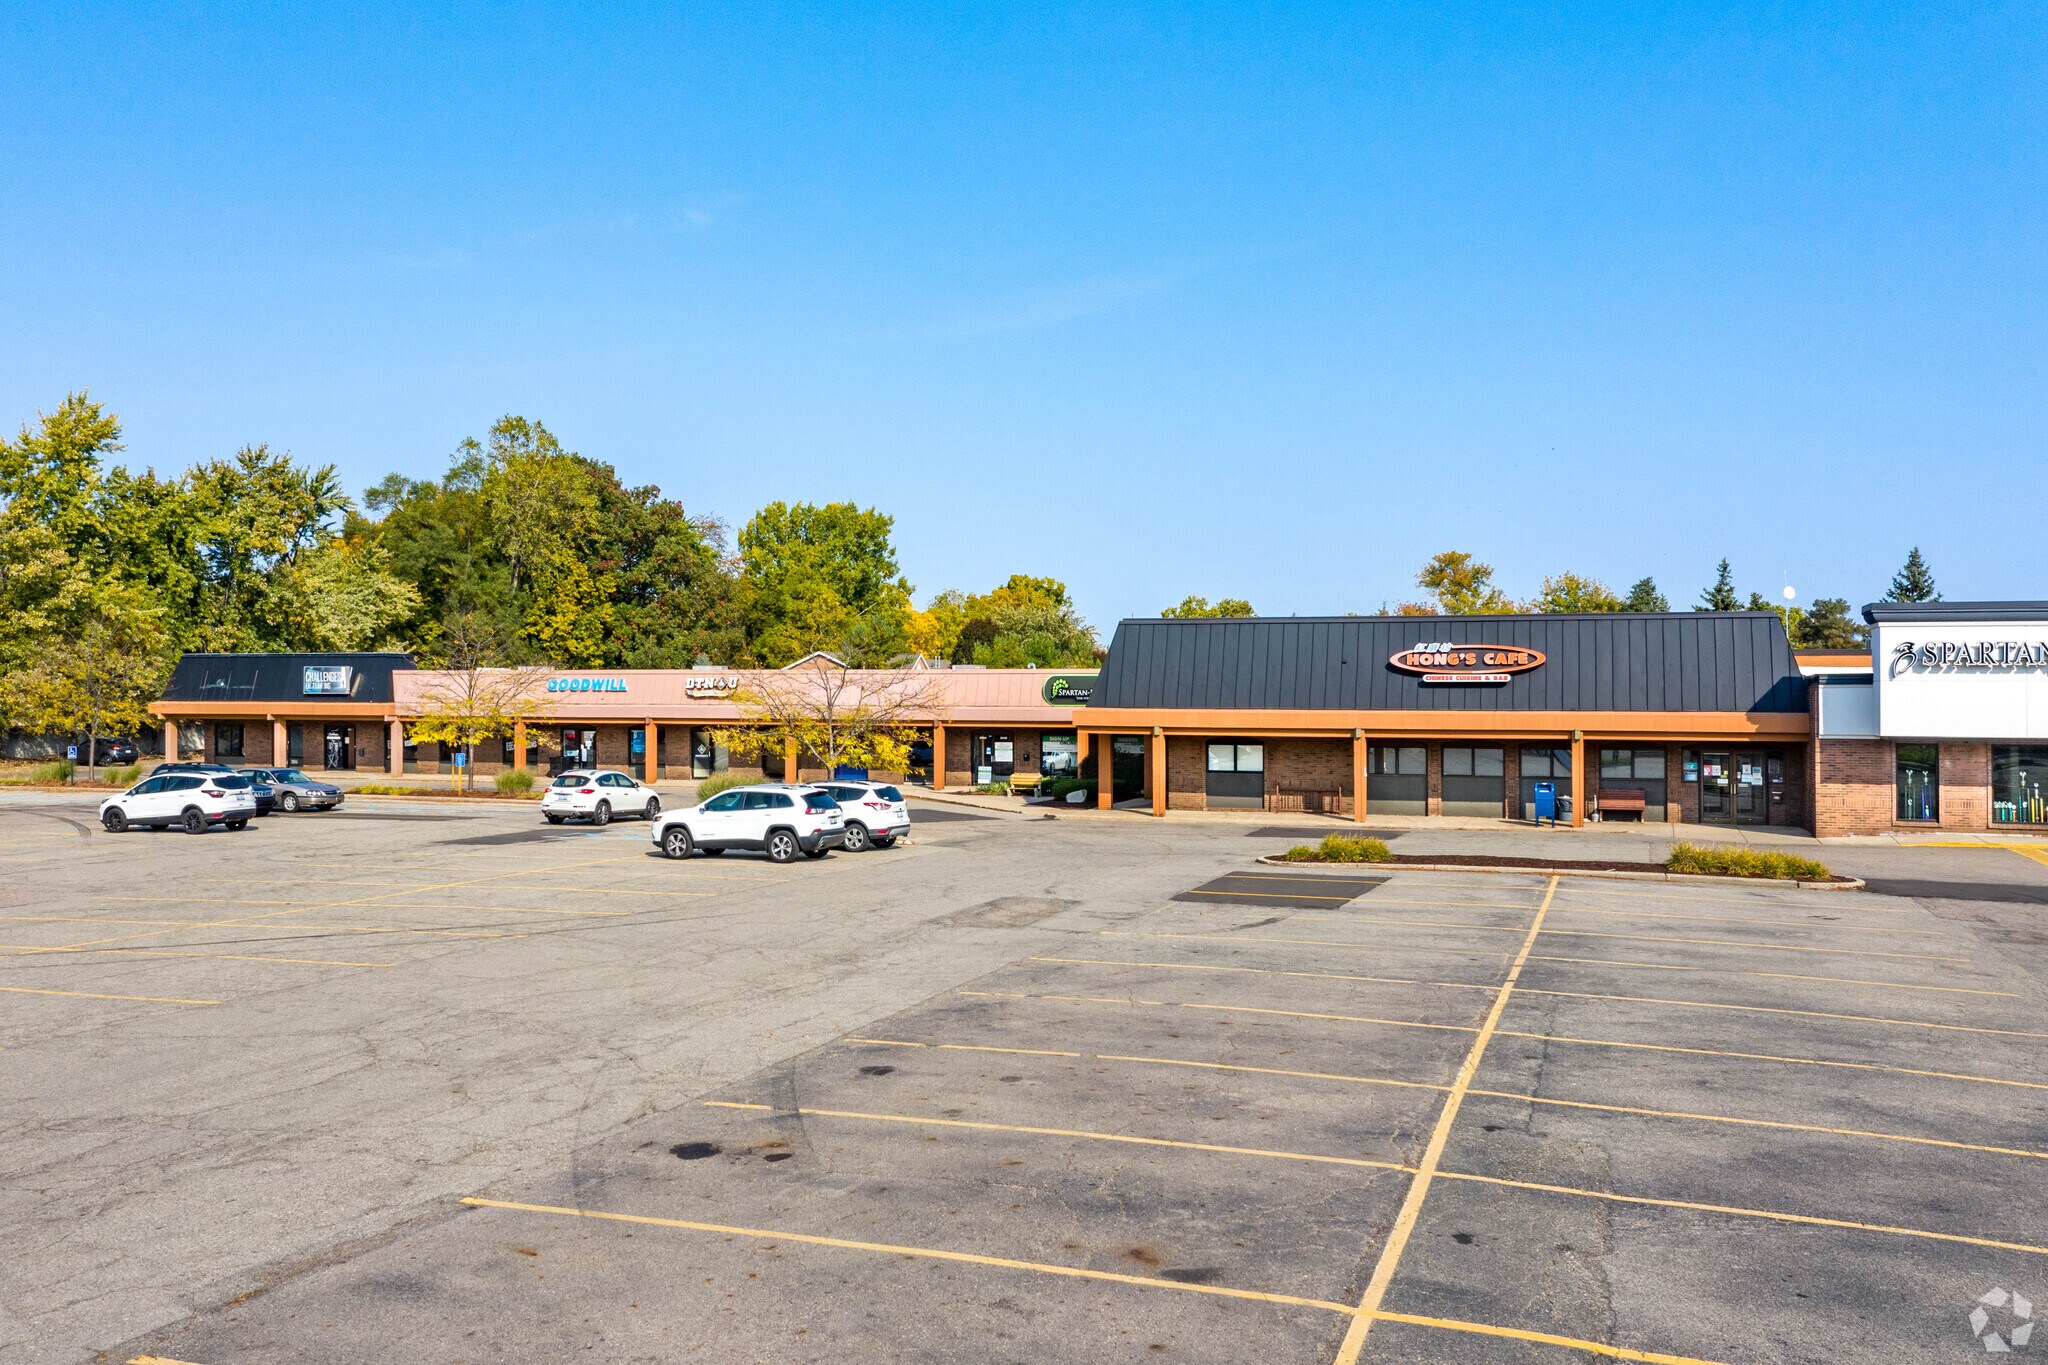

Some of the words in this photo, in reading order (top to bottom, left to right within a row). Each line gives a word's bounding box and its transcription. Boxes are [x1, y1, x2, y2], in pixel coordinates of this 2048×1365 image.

[1406, 653, 1477, 666] HONG'S
[1484, 653, 1529, 666] CAFE
[547, 678, 628, 692] GOODWILL
